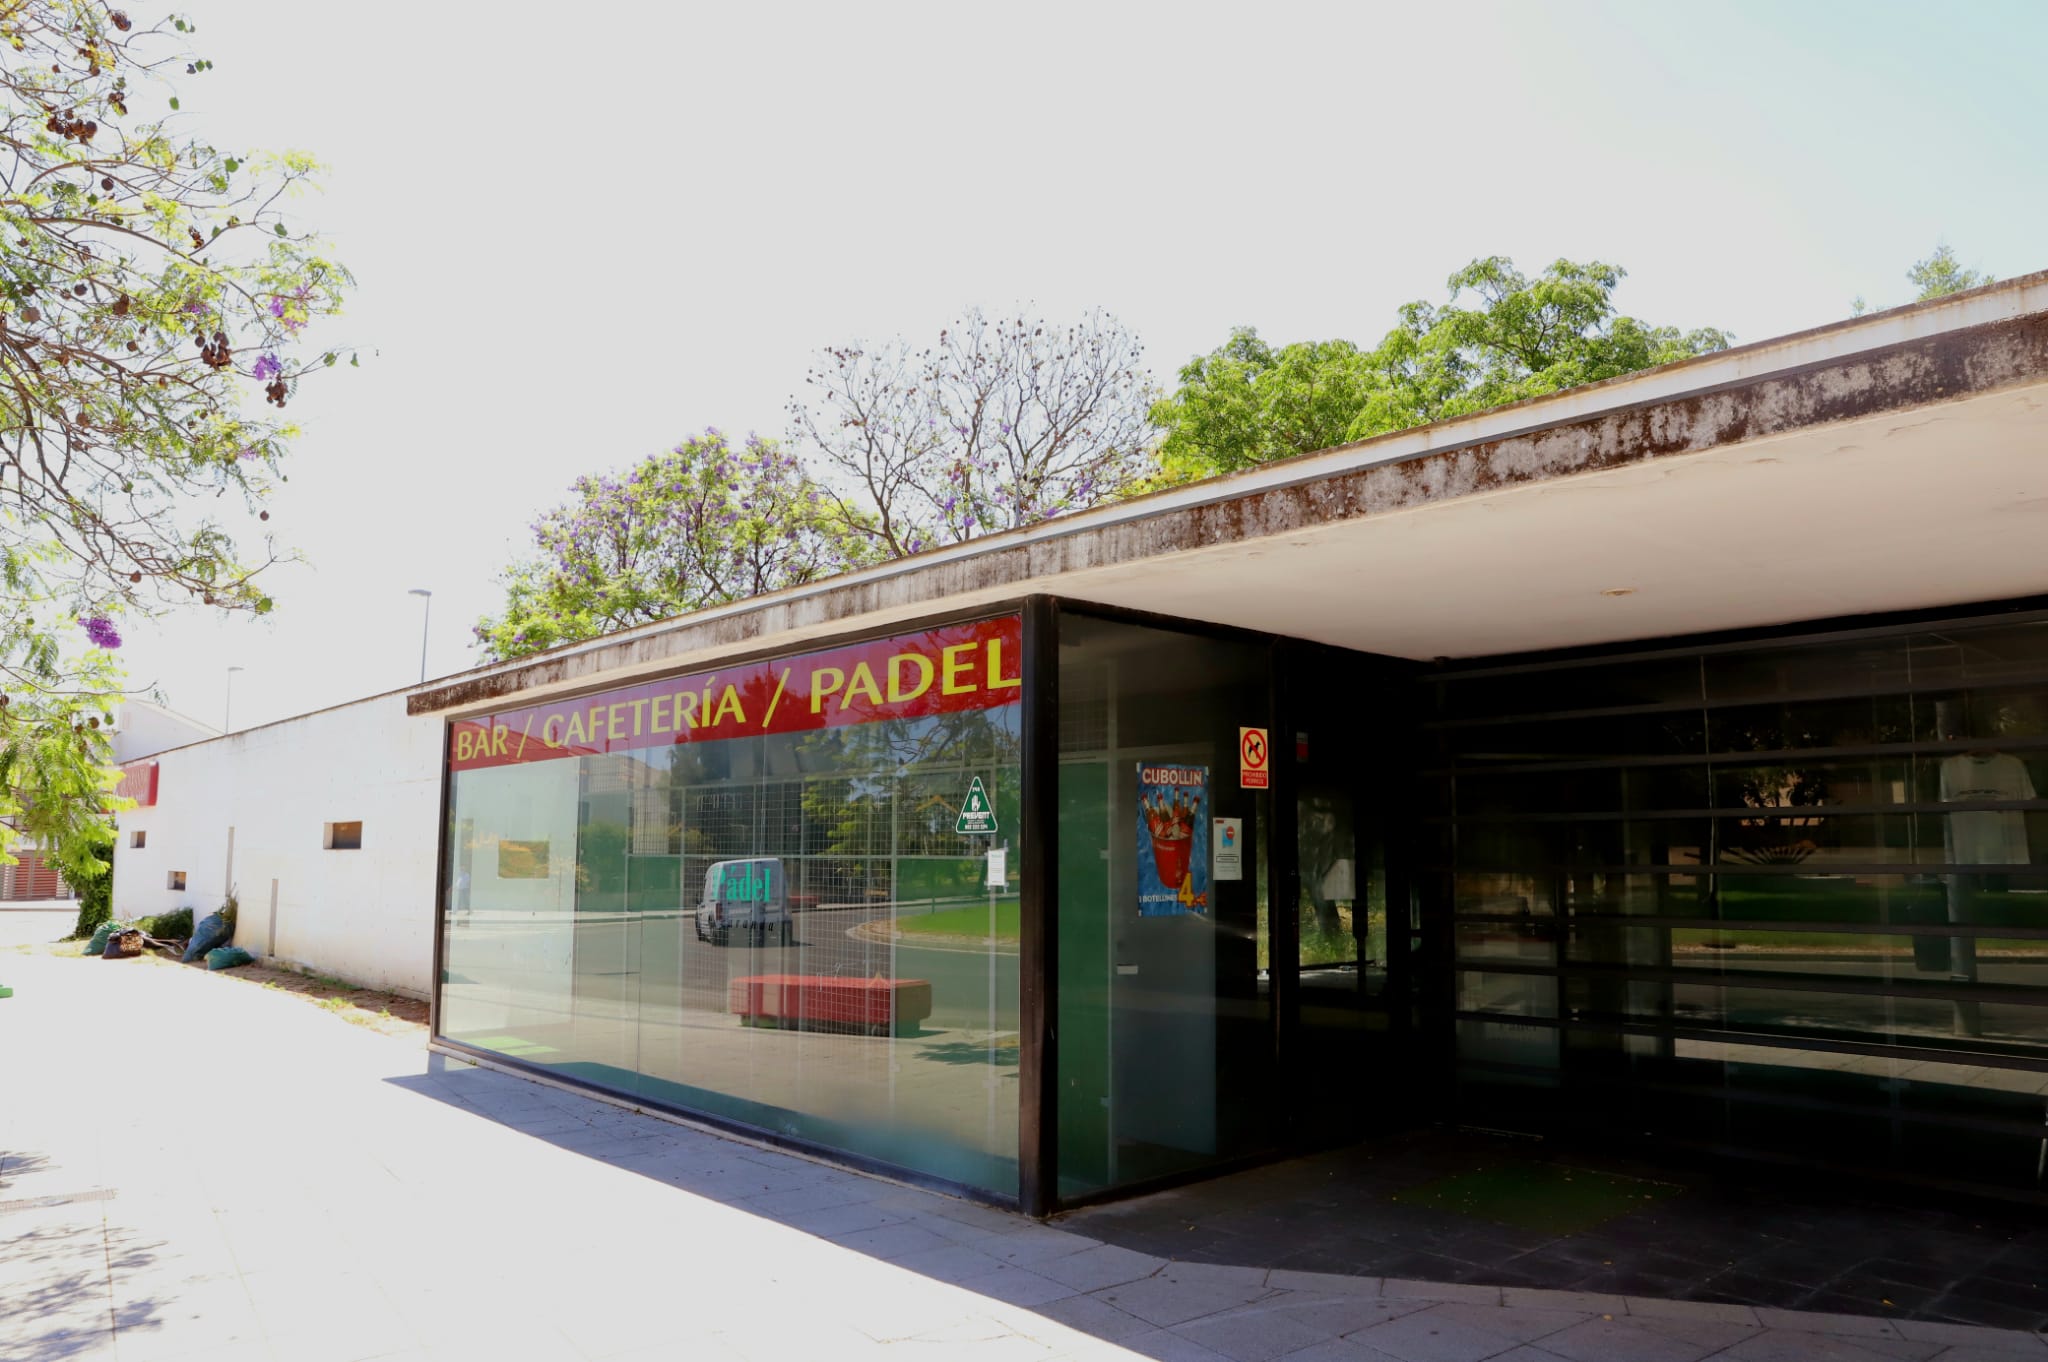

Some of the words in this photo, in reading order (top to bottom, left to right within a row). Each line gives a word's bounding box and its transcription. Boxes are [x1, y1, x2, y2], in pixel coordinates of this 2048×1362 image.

[457, 724, 508, 761] BAR
[516, 713, 534, 759] /
[543, 675, 747, 749] CAFETERÍA
[762, 667, 791, 728] /
[810, 638, 1022, 714] PADEL
[1142, 767, 1203, 785] CUBOLLIN
[711, 863, 771, 903] Pádel
